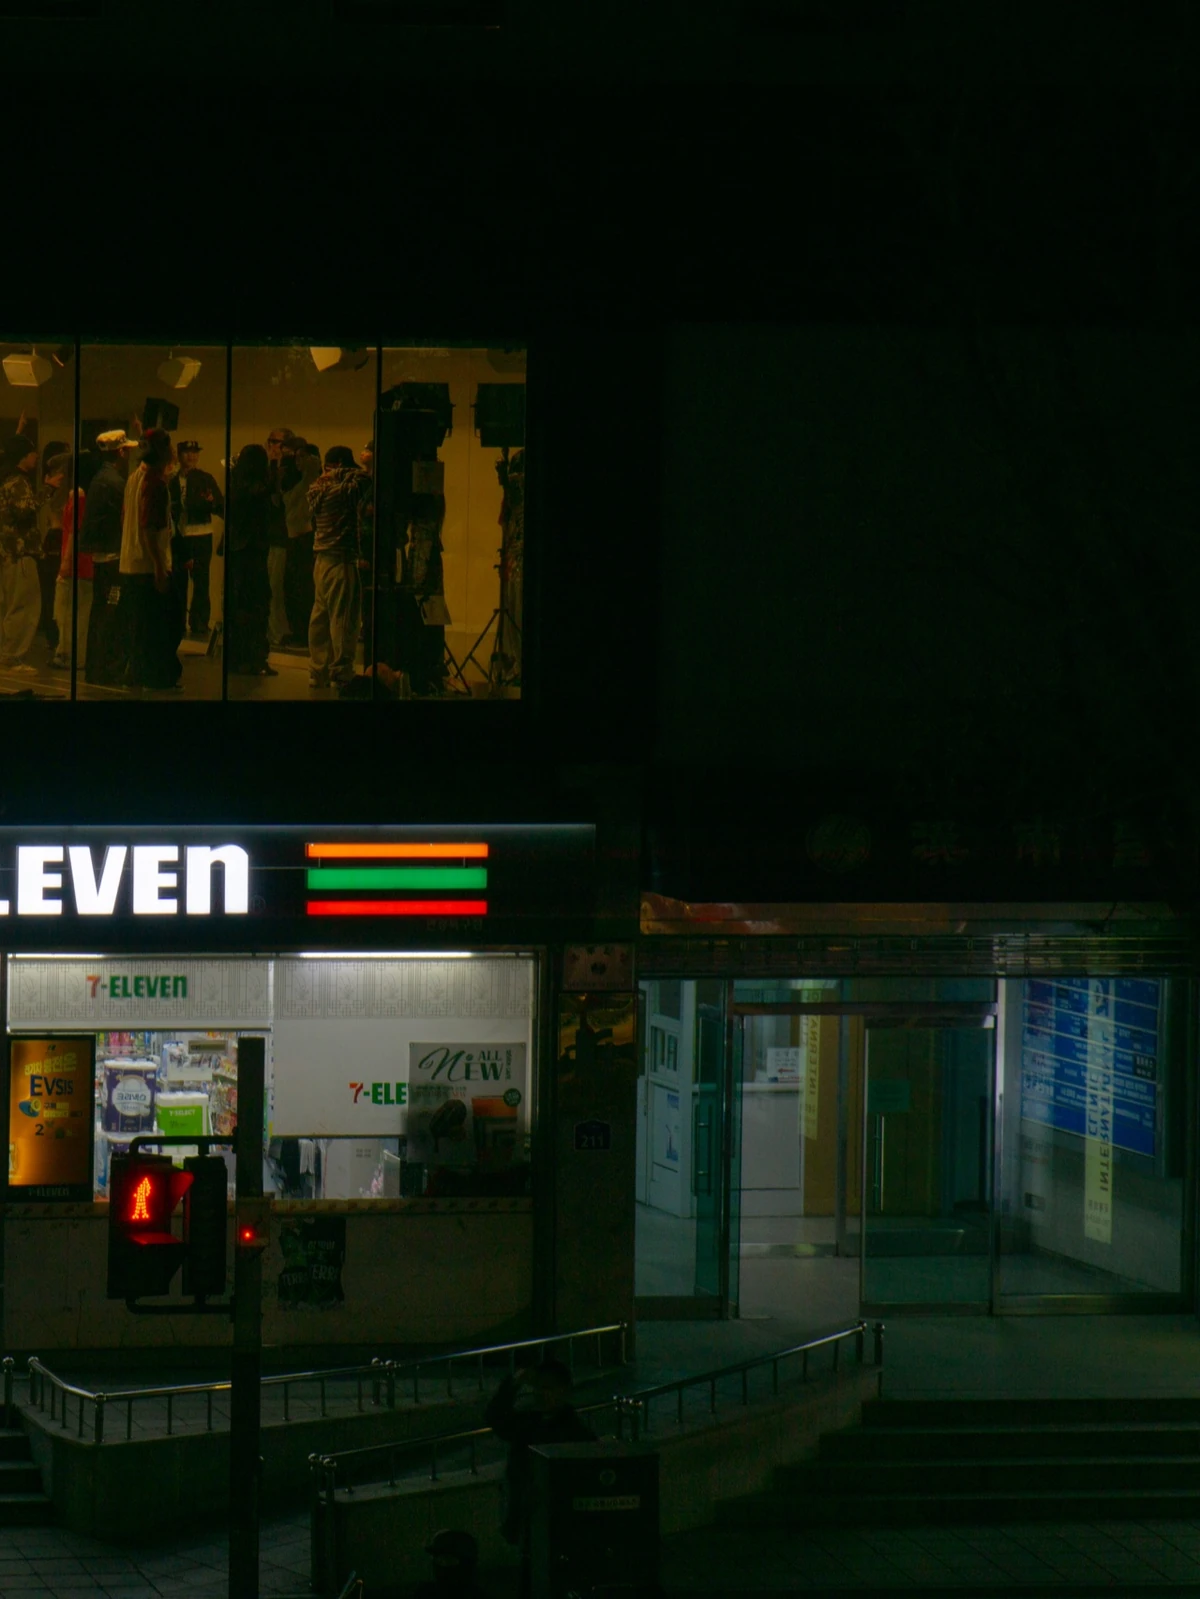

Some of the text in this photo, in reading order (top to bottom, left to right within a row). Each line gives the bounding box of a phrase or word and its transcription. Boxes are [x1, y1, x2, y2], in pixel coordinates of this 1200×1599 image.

[30, 1075, 74, 1097] EVSIS
[349, 1082, 407, 1105] 7-ELE
[580, 1132, 604, 1148] 211
